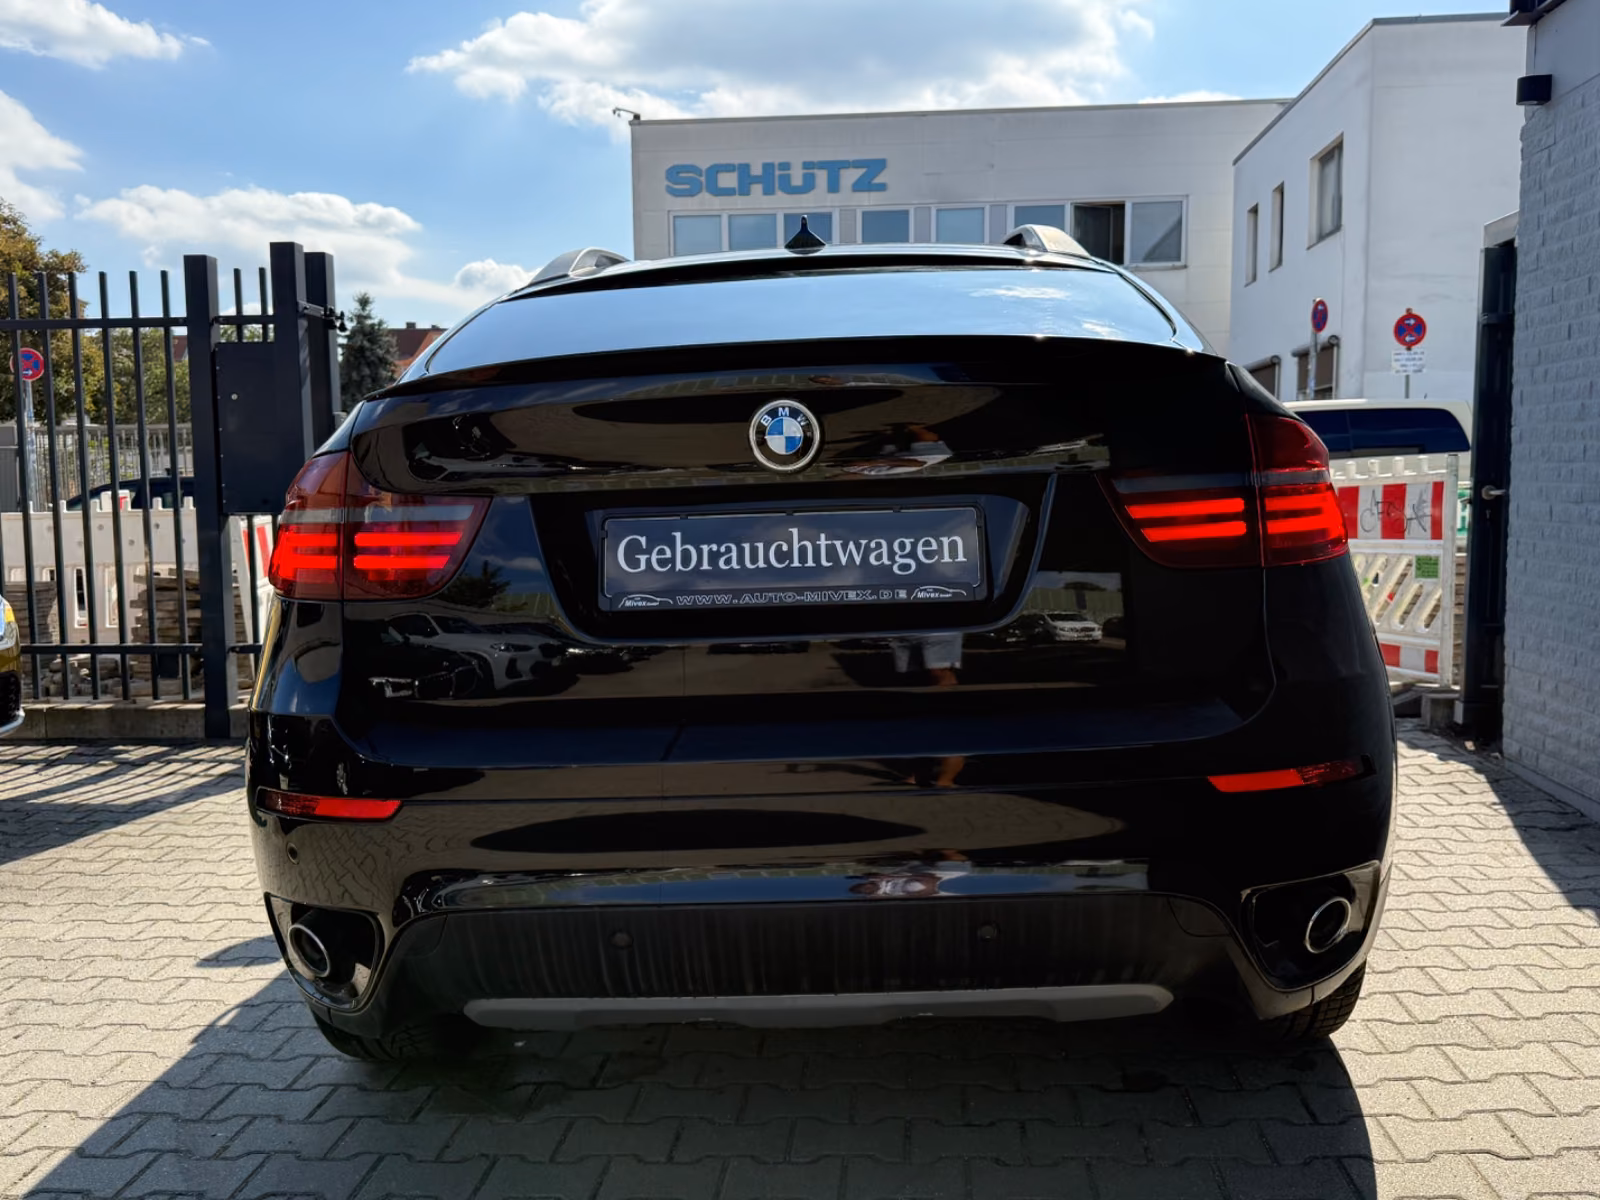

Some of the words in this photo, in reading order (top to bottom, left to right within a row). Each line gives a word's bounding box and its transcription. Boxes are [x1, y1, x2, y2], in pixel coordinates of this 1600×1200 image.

[665, 158, 888, 198] SCHÜTZ
[760, 406, 809, 427] BMW
[616, 528, 968, 575] Gebrauchtwagen
